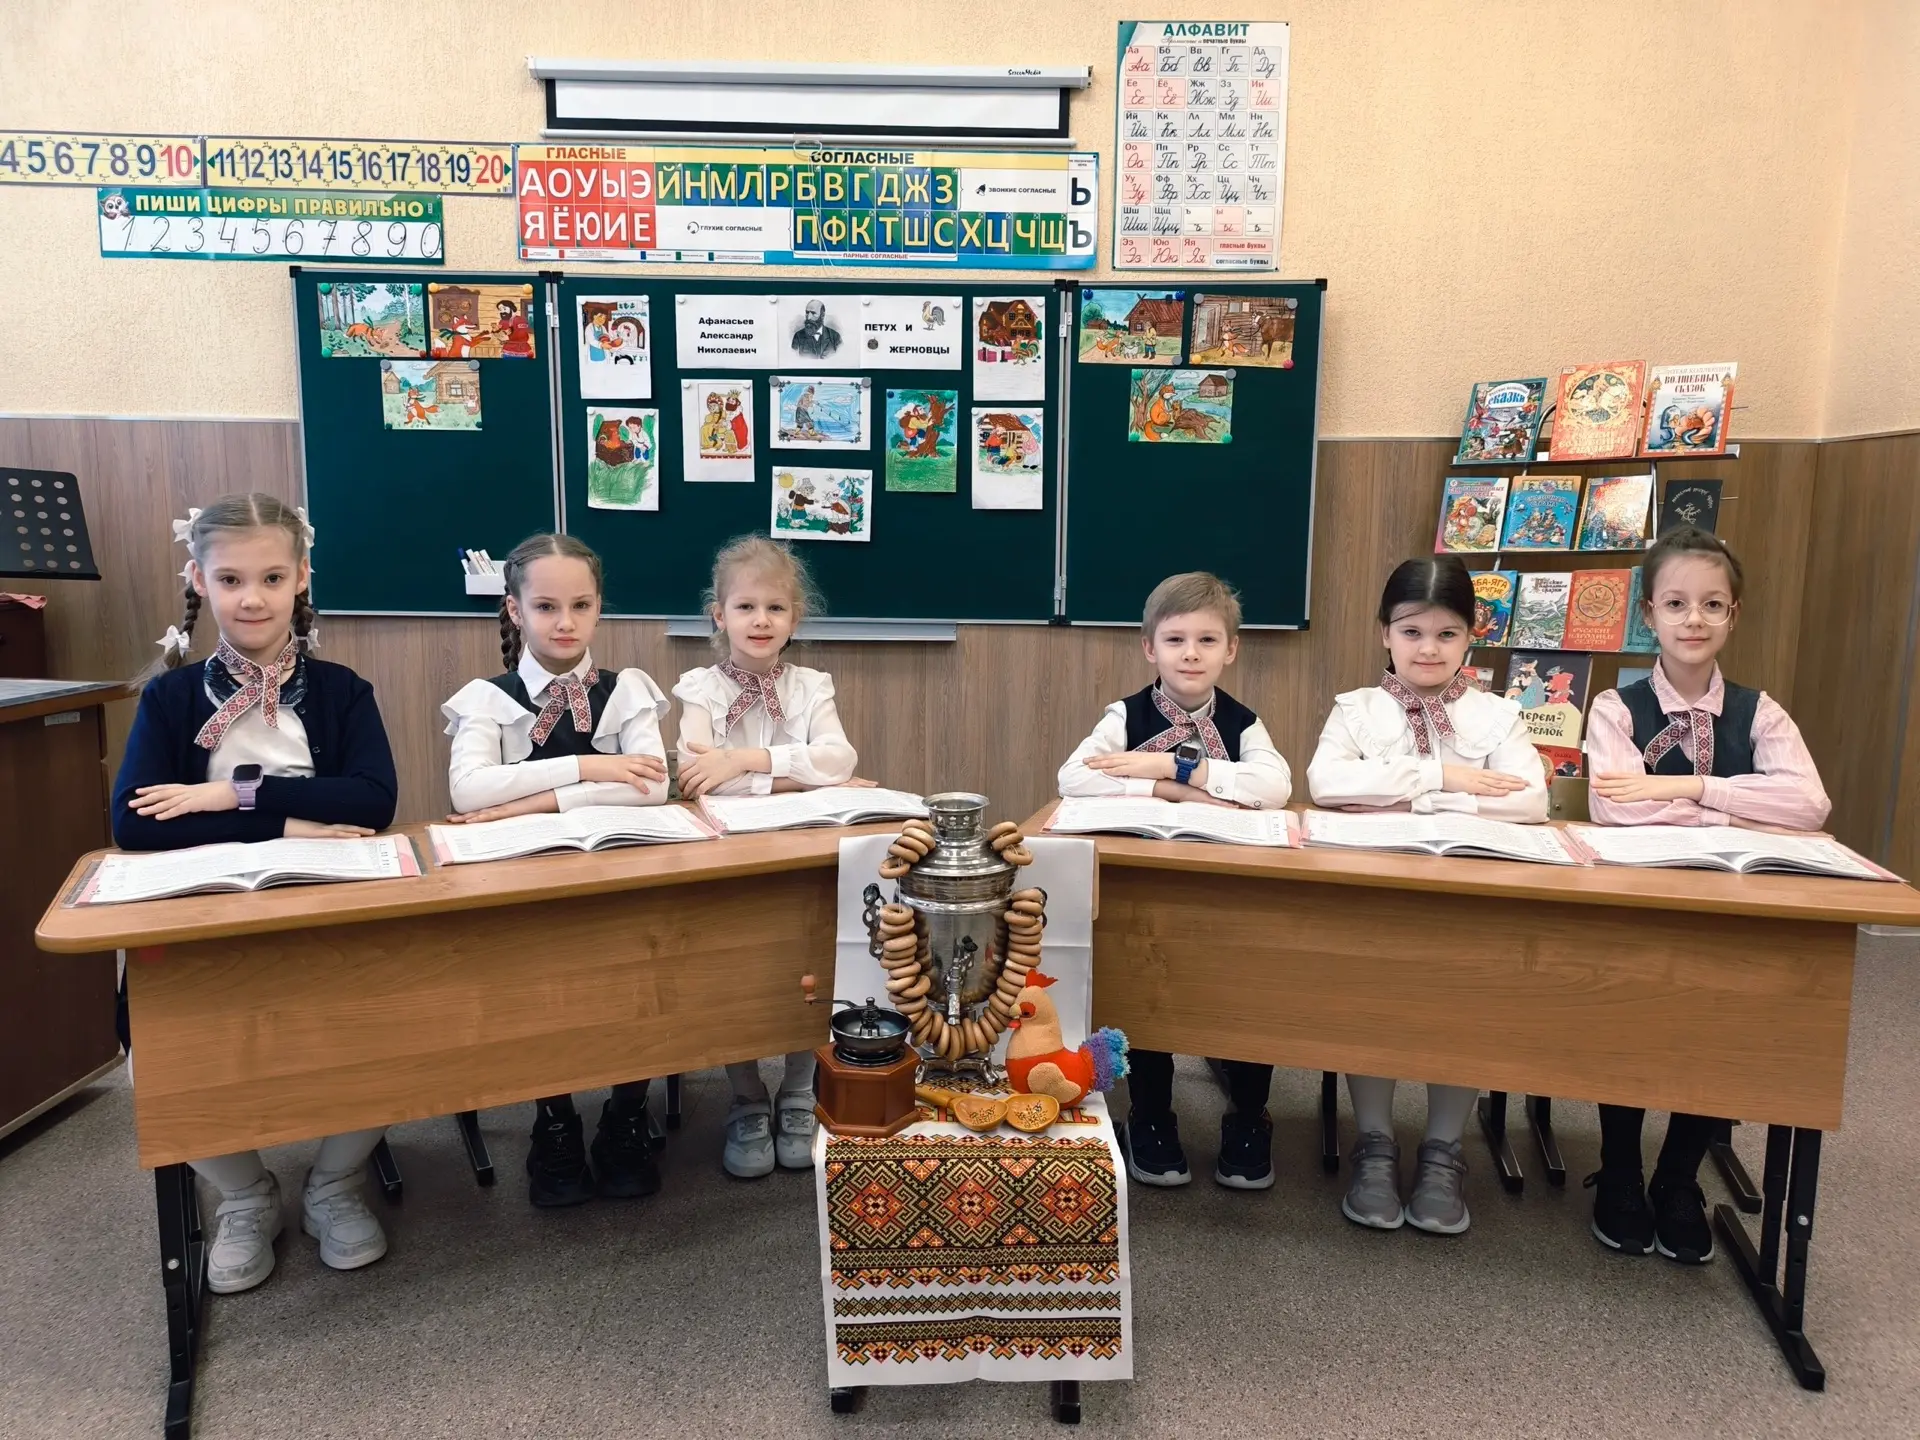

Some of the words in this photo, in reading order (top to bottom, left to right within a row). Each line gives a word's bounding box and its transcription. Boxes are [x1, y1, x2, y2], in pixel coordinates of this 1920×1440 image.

[1163, 23, 1250, 36] АЛФАВИТ
[1159, 46, 1171, 54] Бб
[1253, 47, 1266, 55] Дд
[1158, 79, 1168, 88] Ёё
[1220, 80, 1231, 88] Зз
[1252, 80, 1264, 88] Ии
[1126, 110, 1138, 120] Йй
[1157, 112, 1169, 120] Кк
[1188, 112, 1200, 120] Лл
[1219, 112, 1236, 120] Мм
[1250, 112, 1263, 121] Нн
[1125, 143, 1137, 151] Оо
[1187, 144, 1199, 153] Рр
[0, 140, 20, 173] 4
[27, 141, 46, 173] 5
[54, 142, 75, 174] 6
[81, 143, 100, 175] 7
[110, 144, 129, 176] 8
[136, 144, 156, 176] 9
[160, 144, 193, 177] 10
[546, 147, 627, 160] ГЛАСНЫЕ
[811, 151, 915, 165] СОГЛАСНЫЕ
[215, 148, 235, 177] 11
[240, 149, 265, 178] 12
[269, 149, 293, 178] 13
[297, 150, 323, 179] 14
[328, 150, 352, 180] 15
[357, 151, 382, 181] 16
[387, 152, 411, 181] 17
[416, 153, 441, 183] 18
[445, 154, 470, 183] 19
[476, 154, 504, 183] 20
[1125, 175, 1135, 183] Уу
[1156, 174, 1170, 183] Фф
[1186, 175, 1197, 183] Хх
[1217, 175, 1230, 184] Цц
[1248, 175, 1260, 184] Чч
[135, 194, 200, 212] ПИШИ
[207, 196, 287, 215] ЦИФРЫ
[294, 198, 424, 217] ПРАВИЛЬНО
[1154, 207, 1171, 216] Щщ
[121, 215, 136, 251] 1
[150, 216, 171, 251] 2
[184, 217, 205, 252] 3
[219, 217, 238, 254] 4
[252, 218, 271, 254] 5
[285, 218, 304, 255] 6
[318, 219, 338, 255] 7
[351, 220, 372, 256] 8
[387, 221, 407, 257] 9
[420, 222, 441, 258] 0
[1184, 239, 1196, 247] Яя
[698, 317, 754, 326] Афанасьев
[700, 331, 753, 341] Александр
[697, 346, 757, 354] Николаевич
[889, 346, 950, 355] ЖЕРНОВЦЫ
[1665, 374, 1719, 384] ВОЛШЕБНЫХ
[1675, 384, 1706, 393] СКАЗОК
